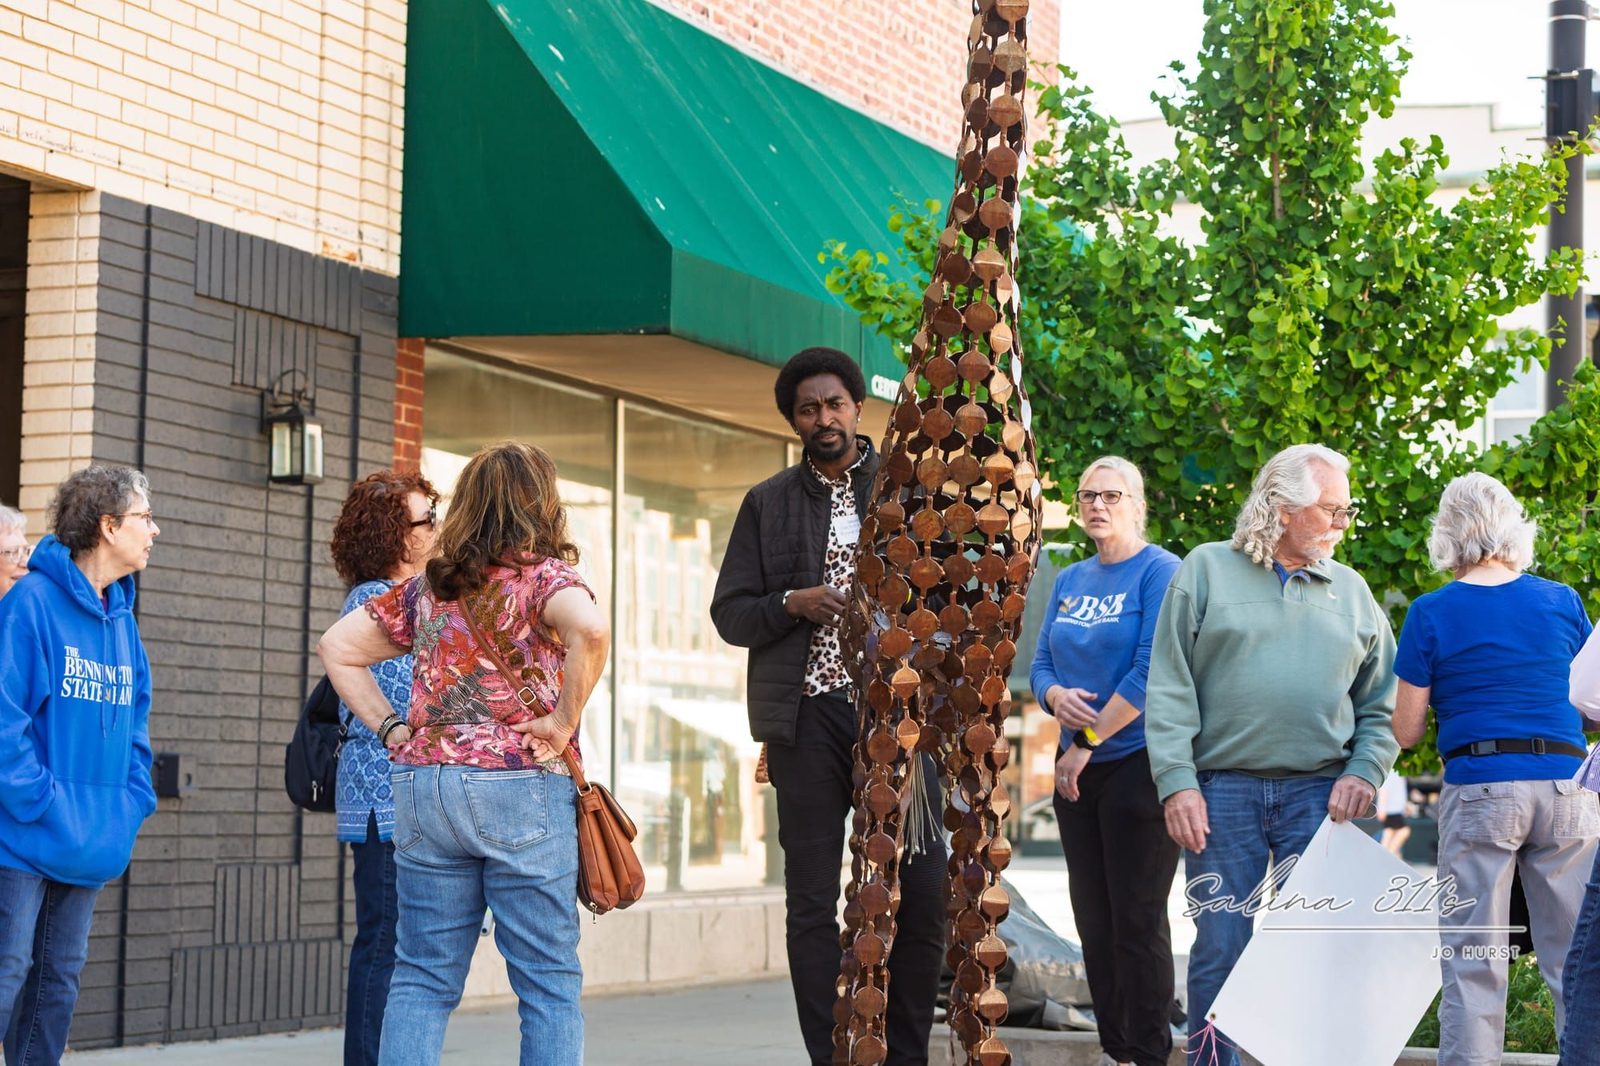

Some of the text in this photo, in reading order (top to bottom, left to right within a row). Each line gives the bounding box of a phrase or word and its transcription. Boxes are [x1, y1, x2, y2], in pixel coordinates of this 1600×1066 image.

[64, 646, 79, 657] THE
[64, 657, 132, 685] BENNINGTO
[61, 678, 103, 702] STATE
